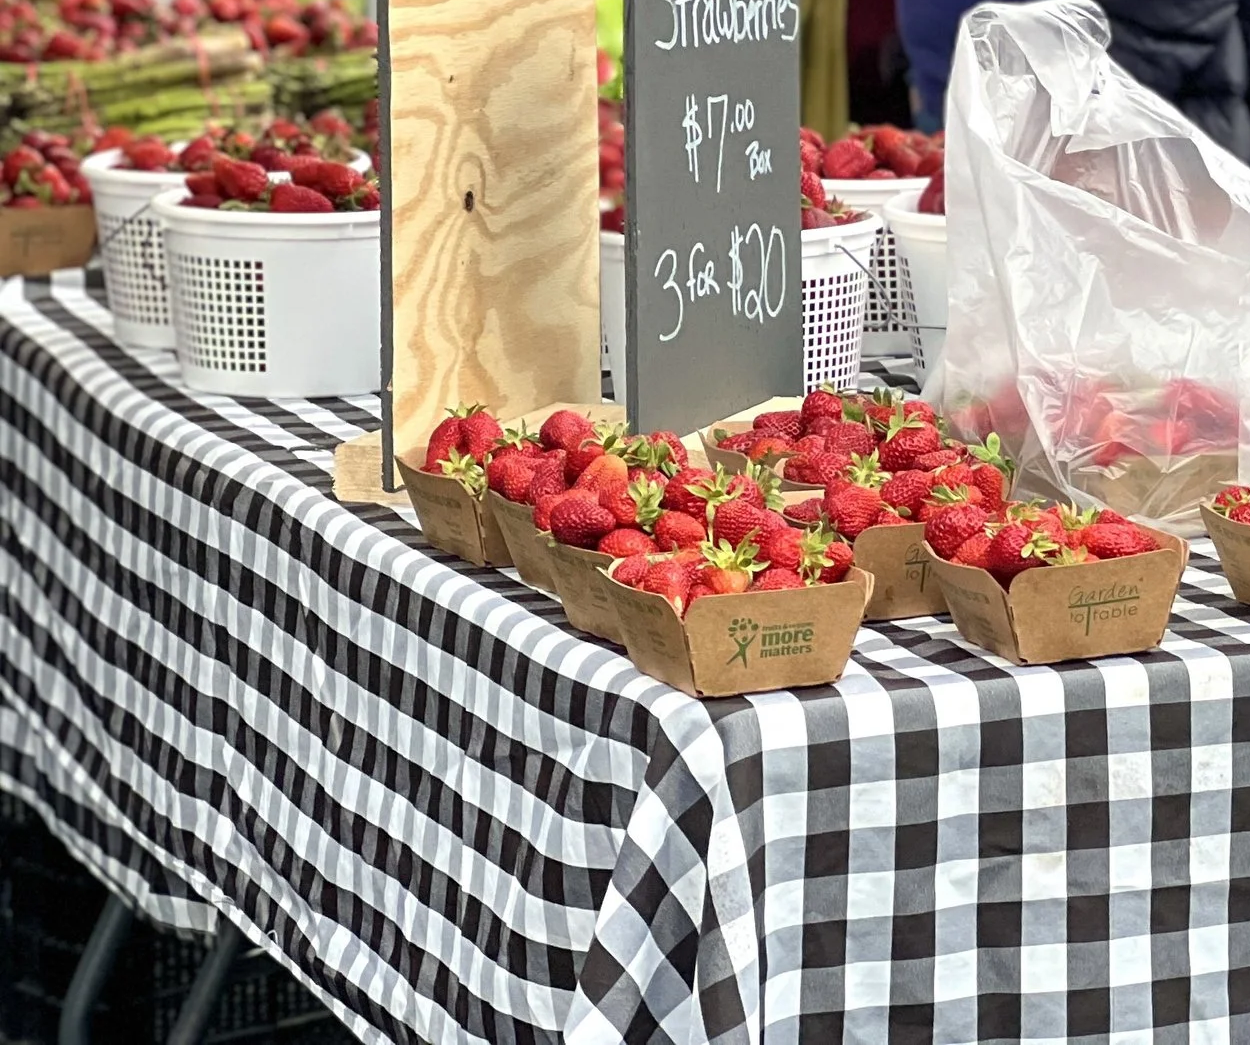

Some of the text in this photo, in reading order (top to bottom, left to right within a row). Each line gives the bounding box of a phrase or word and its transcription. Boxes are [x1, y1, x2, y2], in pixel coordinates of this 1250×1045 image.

[681, 93, 755, 194] $7.00
[654, 248, 684, 342] 3
[728, 222, 787, 325] $20
[1069, 582, 1138, 605] Garden
[761, 628, 814, 647] more
[760, 644, 812, 658] matters
